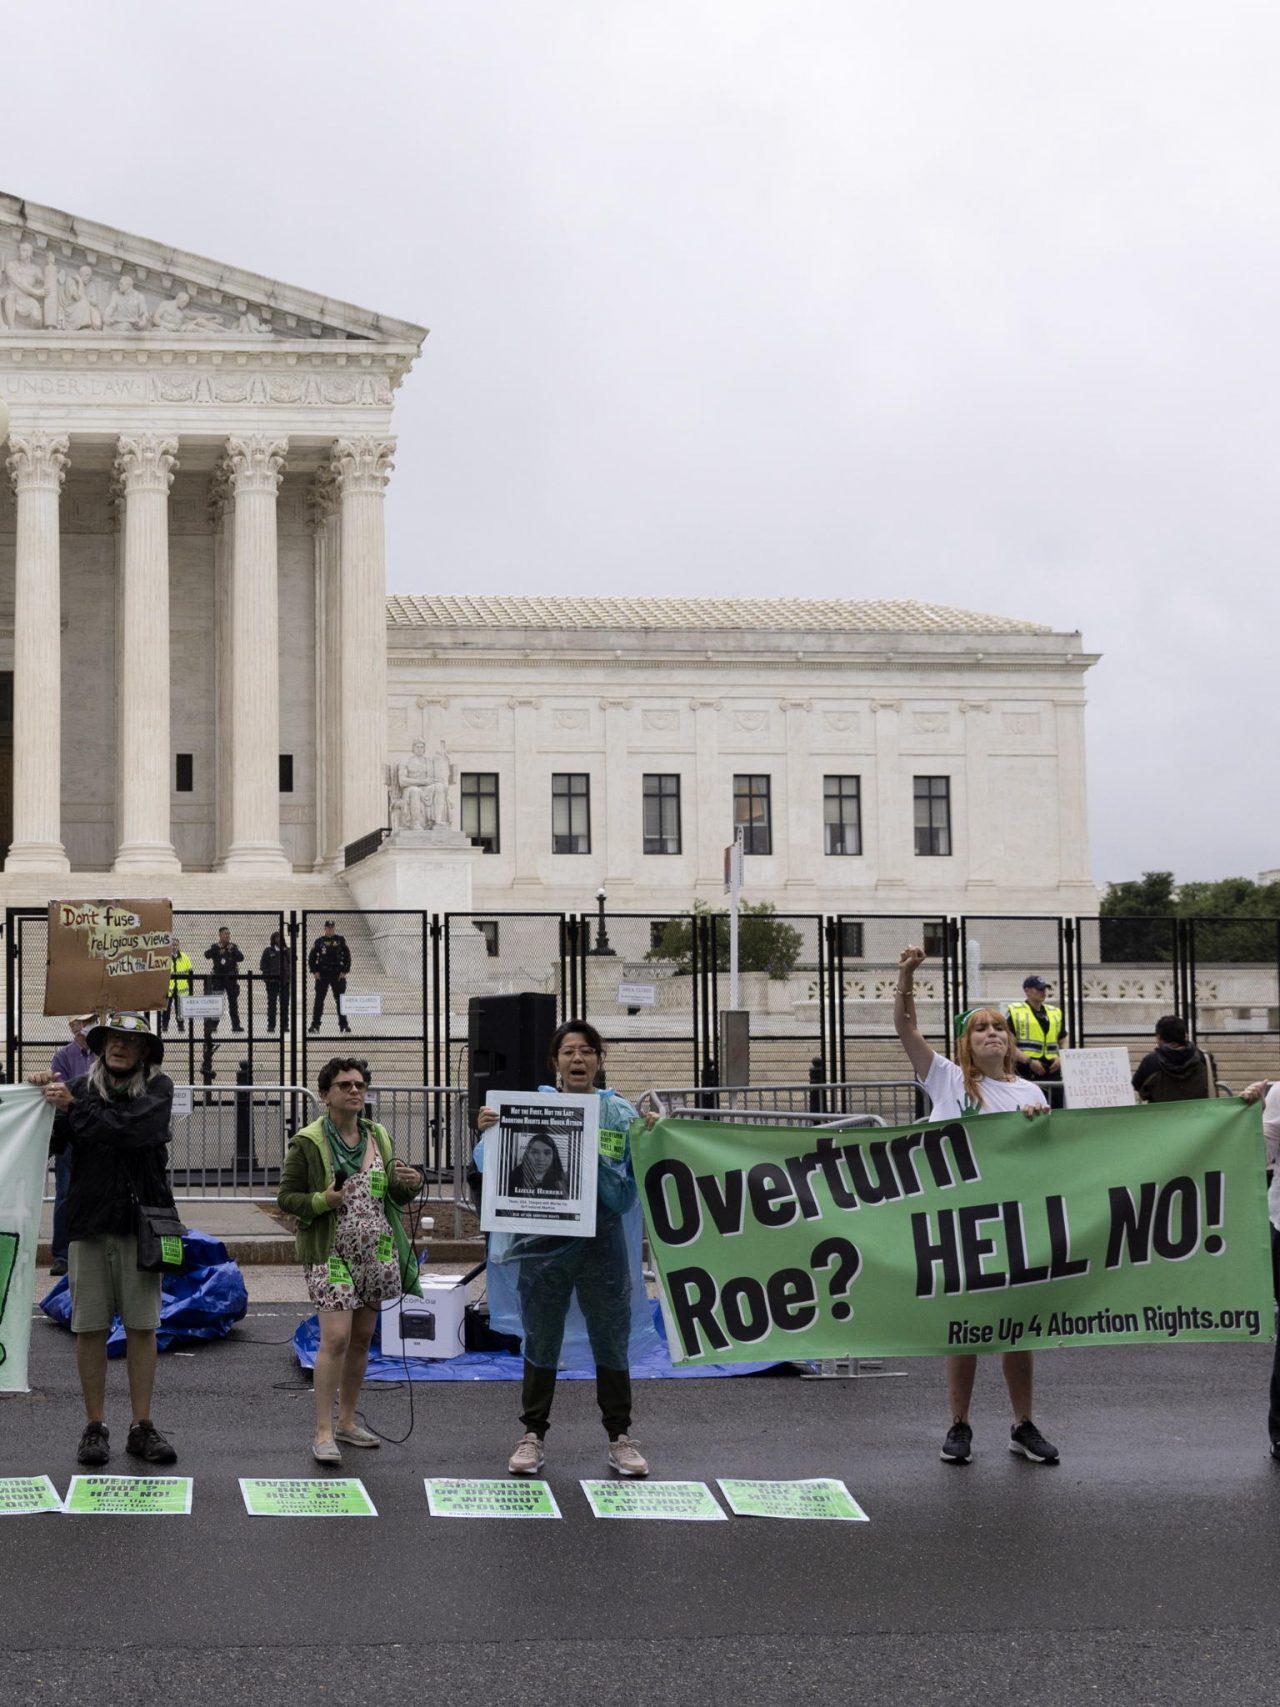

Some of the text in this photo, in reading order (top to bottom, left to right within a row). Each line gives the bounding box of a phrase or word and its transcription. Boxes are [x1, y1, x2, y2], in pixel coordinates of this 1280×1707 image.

[6, 377, 81, 395] UNDER
[91, 379, 134, 396] LAW
[63, 906, 135, 927] Don't fuse
[142, 933, 170, 946] views
[109, 955, 135, 975] with
[148, 953, 168, 970] Law
[644, 1122, 981, 1247] Overturn
[910, 1170, 1227, 1300] HELL NO!
[666, 1237, 863, 1359] Roe?
[948, 1304, 1261, 1346] Rise Up 4 Abortion Rights.org
